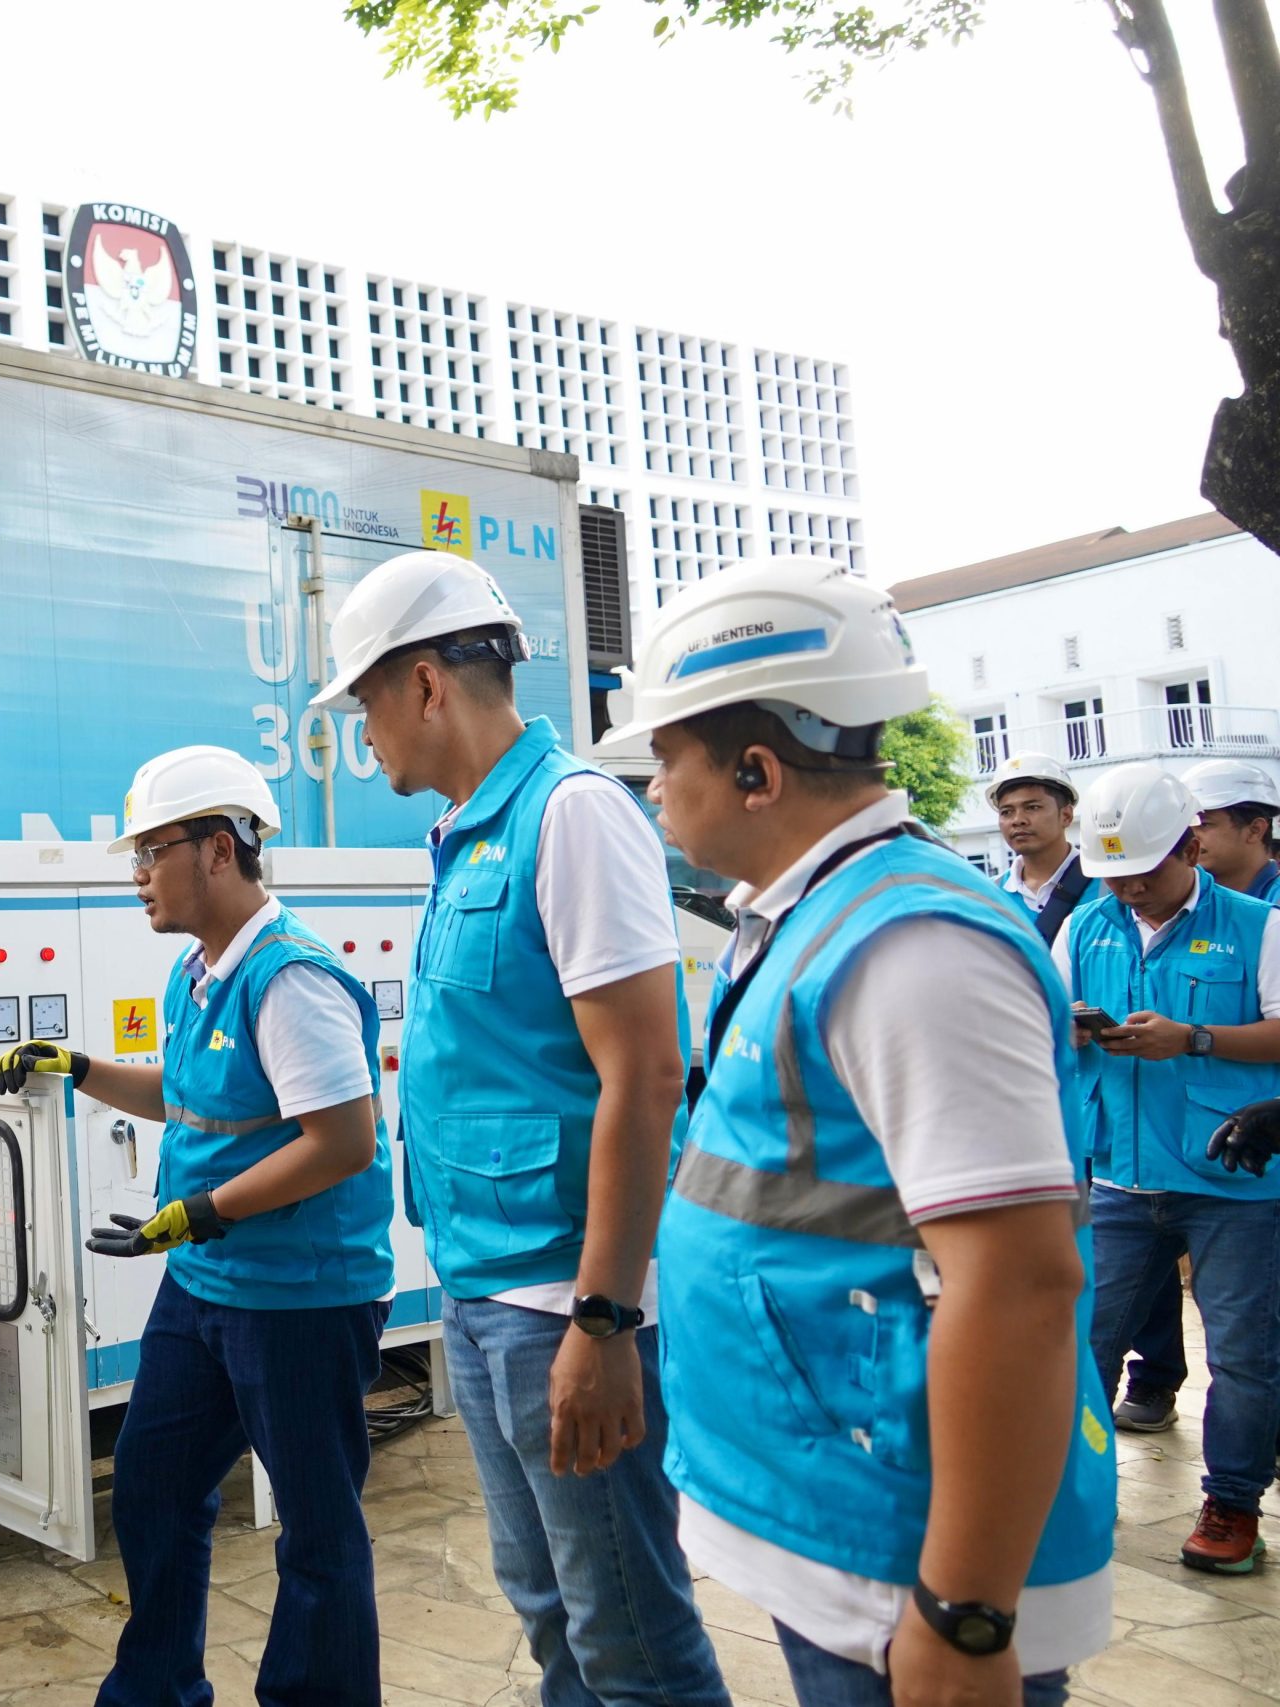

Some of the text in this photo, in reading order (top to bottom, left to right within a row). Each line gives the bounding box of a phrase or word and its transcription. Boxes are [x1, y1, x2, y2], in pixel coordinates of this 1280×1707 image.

[92, 204, 169, 235] KOMISI
[167, 312, 197, 378] UMUM
[343, 507, 379, 523] UNTUK
[344, 521, 400, 538] INDONESIA
[479, 515, 556, 561] PLN
[712, 620, 775, 645] MENTENG
[1106, 853, 1127, 861] PLN
[1207, 942, 1235, 955] PLN
[696, 960, 715, 971] PLN
